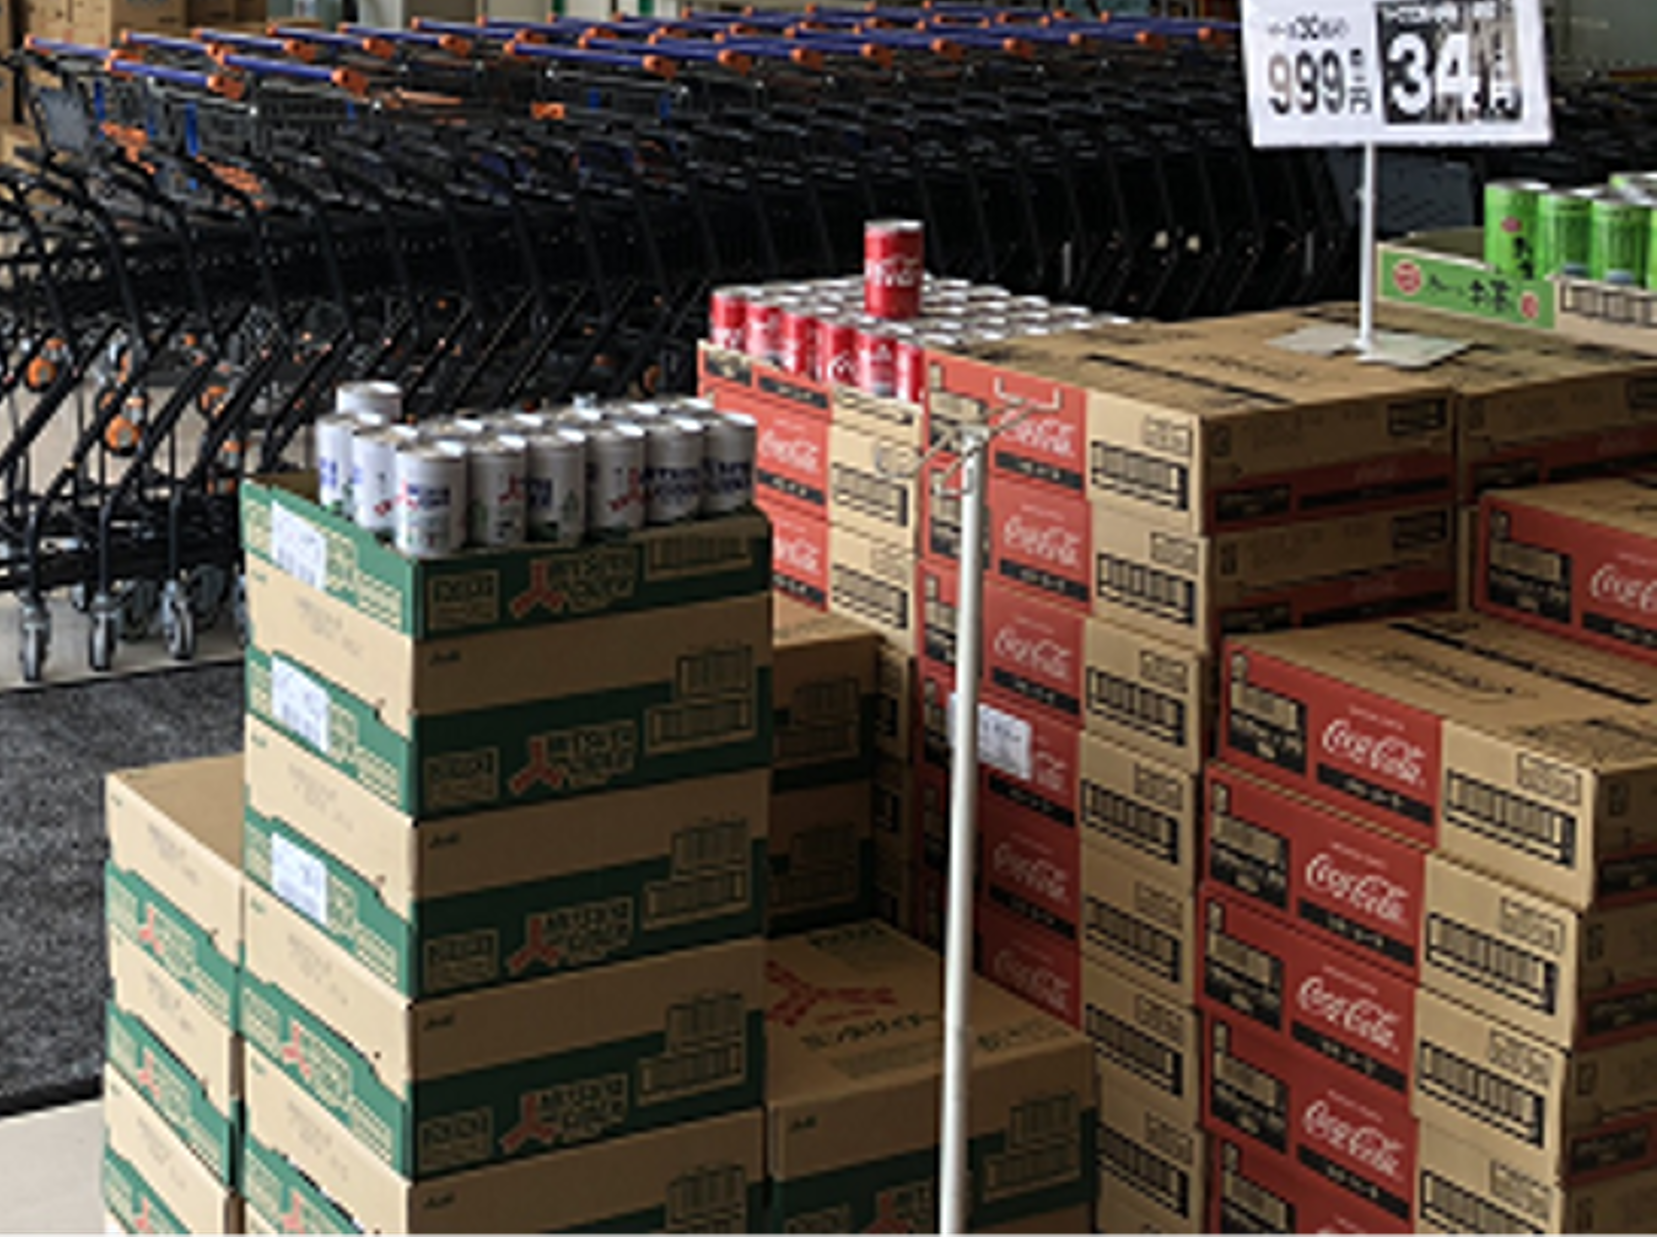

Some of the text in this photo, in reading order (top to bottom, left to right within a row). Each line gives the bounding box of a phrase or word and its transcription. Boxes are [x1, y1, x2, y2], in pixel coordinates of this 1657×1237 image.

[1268, 49, 1344, 115] 999
[1322, 718, 1427, 788] Coca-Cola
[1304, 853, 1410, 924] Coca-Cola
[1296, 975, 1400, 1054] Coca-Cola
